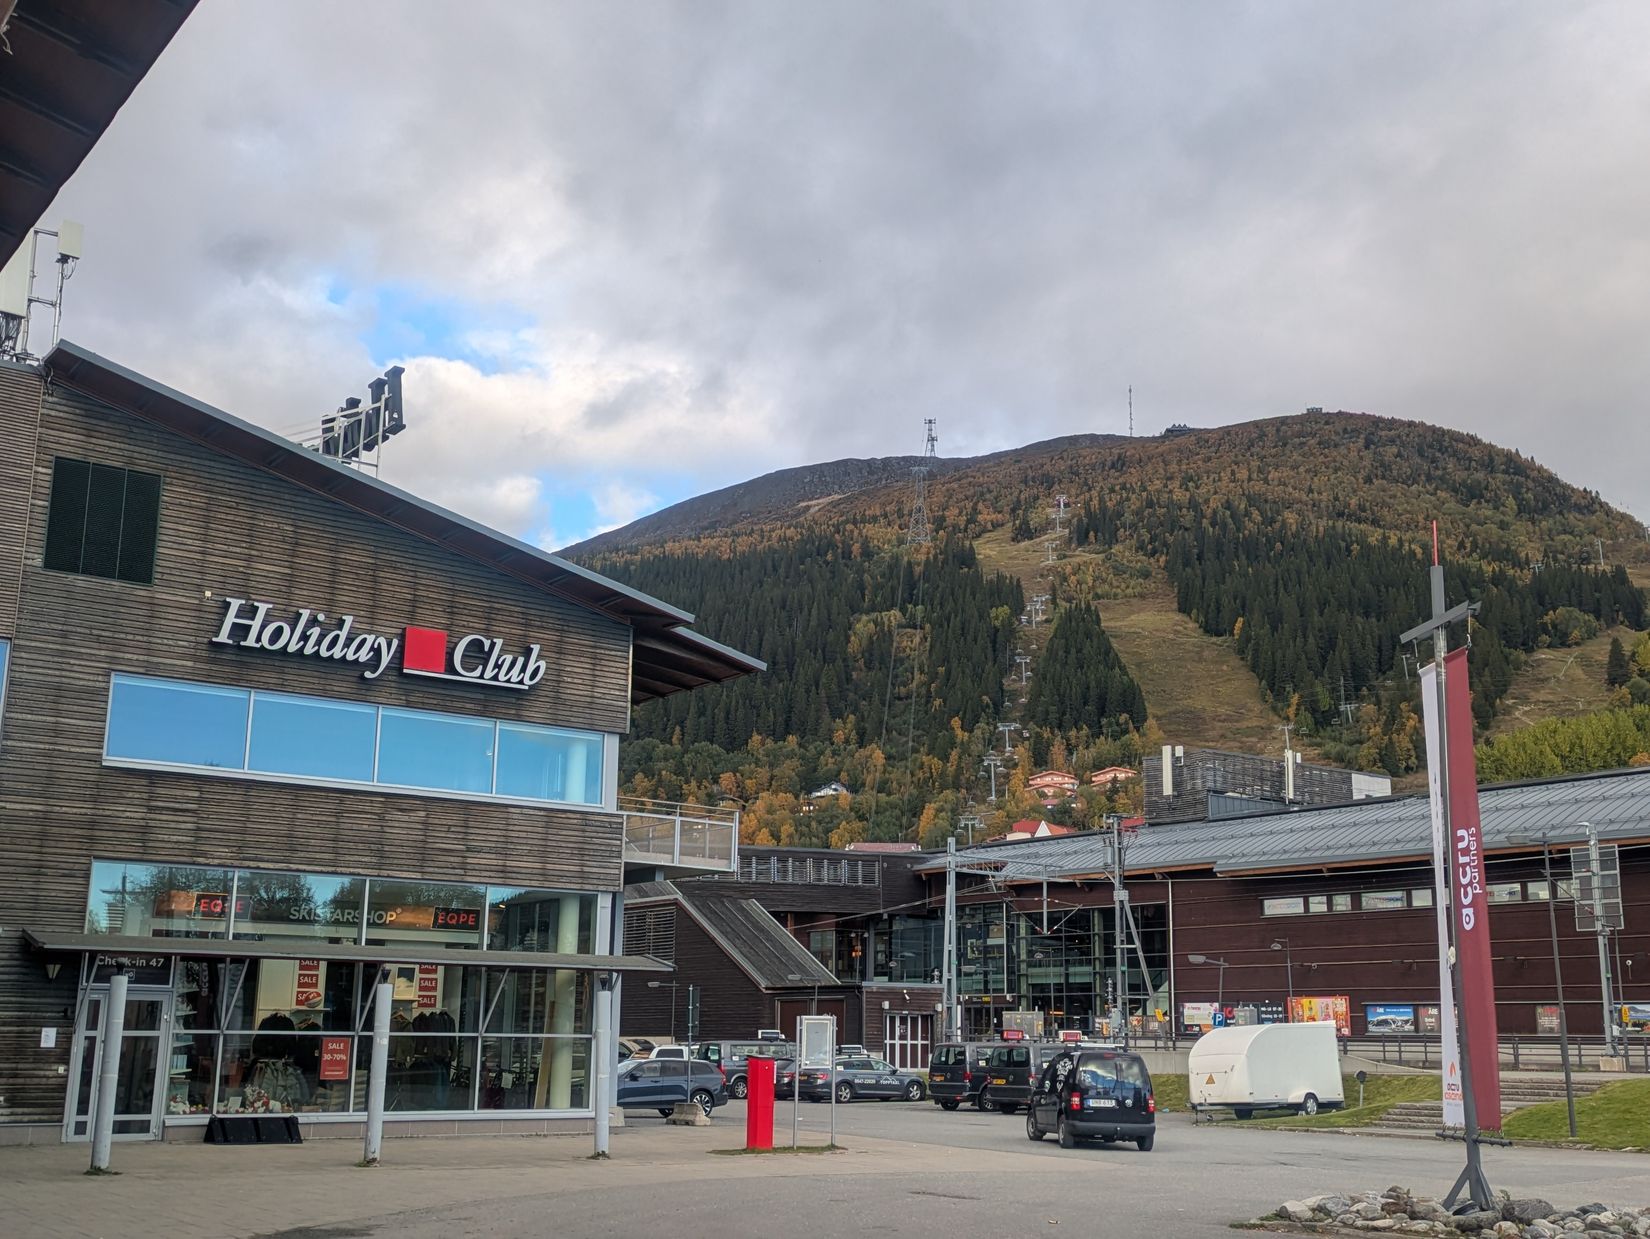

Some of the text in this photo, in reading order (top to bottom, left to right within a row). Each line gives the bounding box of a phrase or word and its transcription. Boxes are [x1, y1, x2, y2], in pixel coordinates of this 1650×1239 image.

[212, 597, 547, 685] Holiday Club
[1469, 827, 1483, 893] partners
[1457, 829, 1475, 931] accru
[200, 899, 244, 912] EQE
[437, 911, 477, 925] EQPE
[97, 956, 165, 967] Chek-in 47
[1216, 1014, 1223, 1025] P
[328, 1042, 344, 1050] SALE
[322, 1053, 347, 1061] 30-70%
